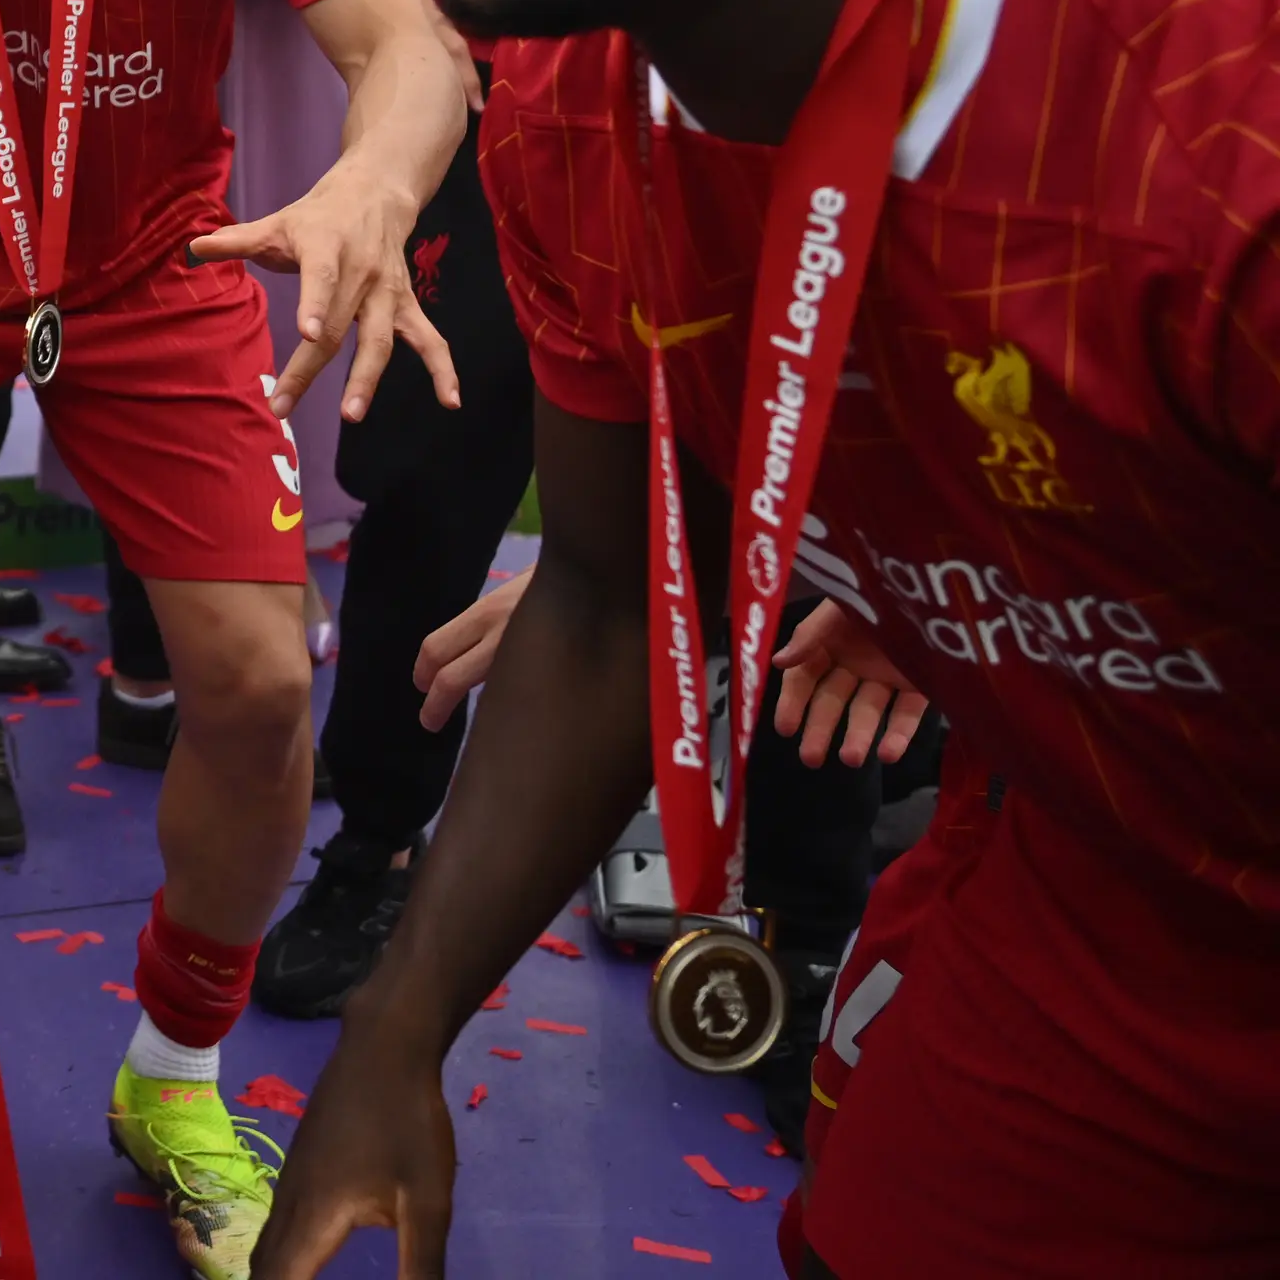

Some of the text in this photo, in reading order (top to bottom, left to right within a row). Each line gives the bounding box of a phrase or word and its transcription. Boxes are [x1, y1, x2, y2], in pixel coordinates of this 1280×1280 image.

[51, 101, 76, 199] League
[750, 186, 847, 526] Premier League
[658, 434, 705, 771] Premier League
